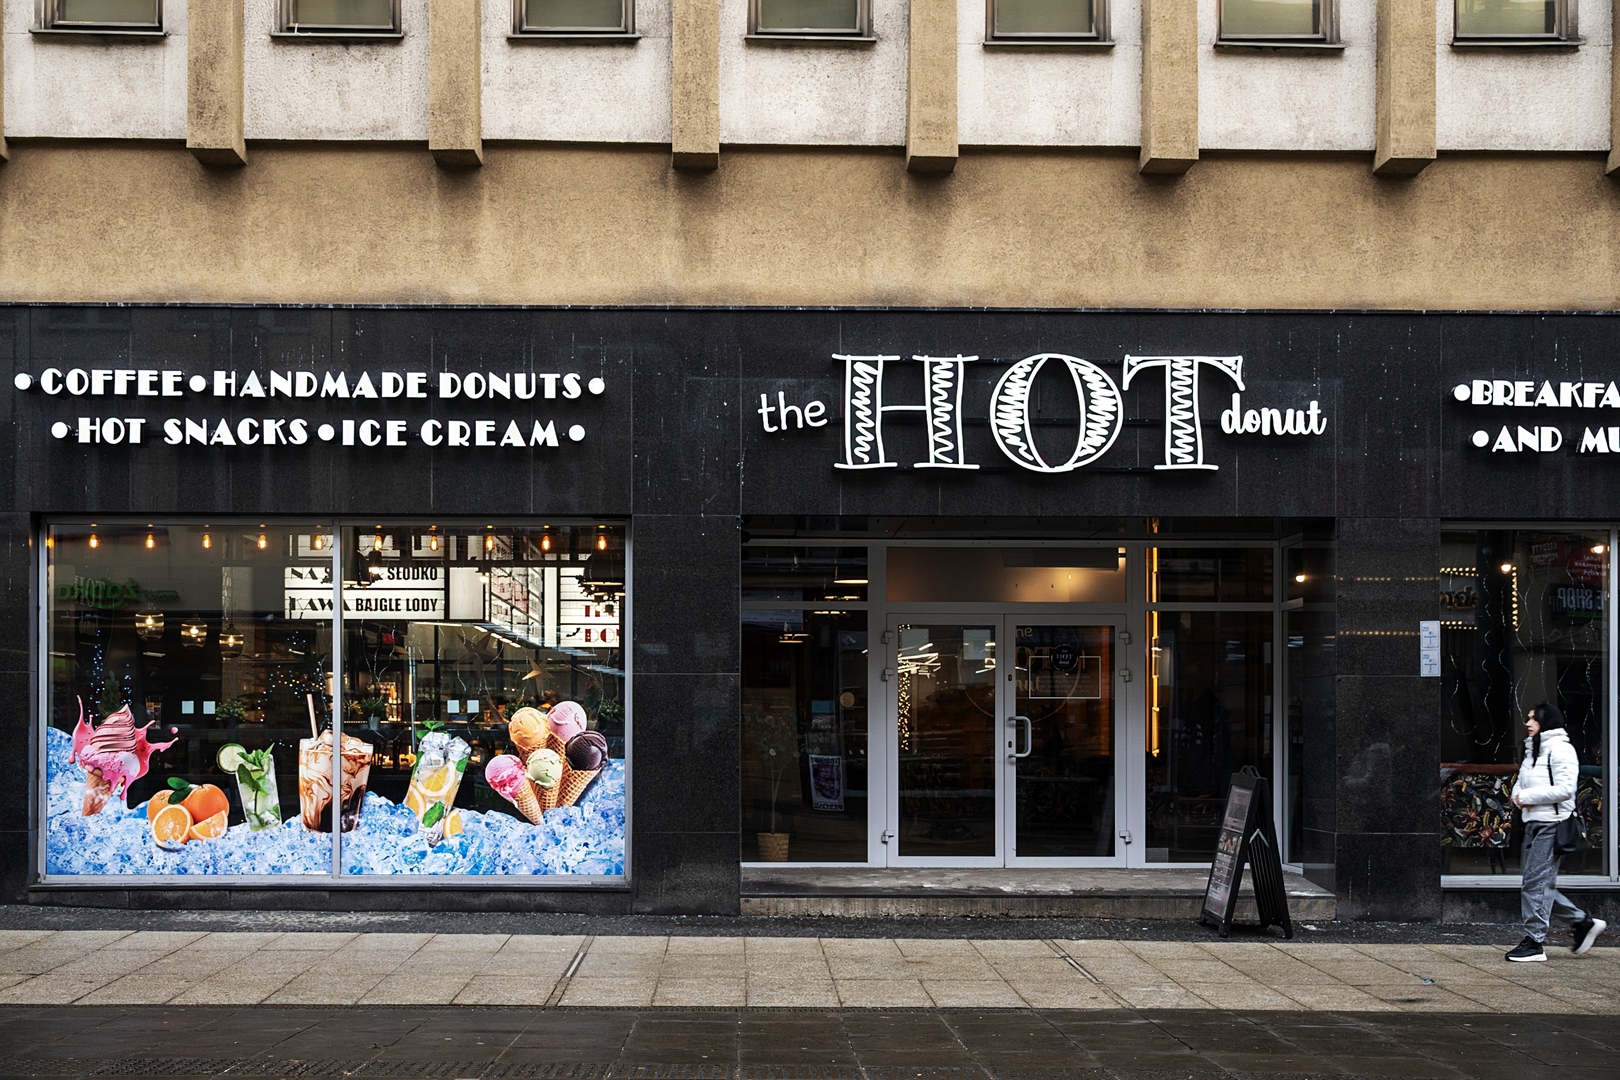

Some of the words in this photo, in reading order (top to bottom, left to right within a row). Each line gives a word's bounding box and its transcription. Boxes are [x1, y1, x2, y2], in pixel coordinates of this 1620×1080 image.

[41, 368, 183, 396] COFFEE
[213, 370, 428, 398] HANDMADE
[440, 372, 582, 399] DONUTS
[1472, 380, 1620, 408] BREAKFA
[758, 391, 828, 432] the
[832, 353, 1245, 473] HOT
[1221, 393, 1328, 436] donut
[79, 418, 147, 444] HOT
[164, 418, 308, 445] SNACKS
[343, 420, 408, 446] ICE
[421, 420, 559, 447] CREAM
[1492, 426, 1563, 453] AND
[356, 598, 401, 612] BAJGLE
[406, 598, 438, 612] LODY
